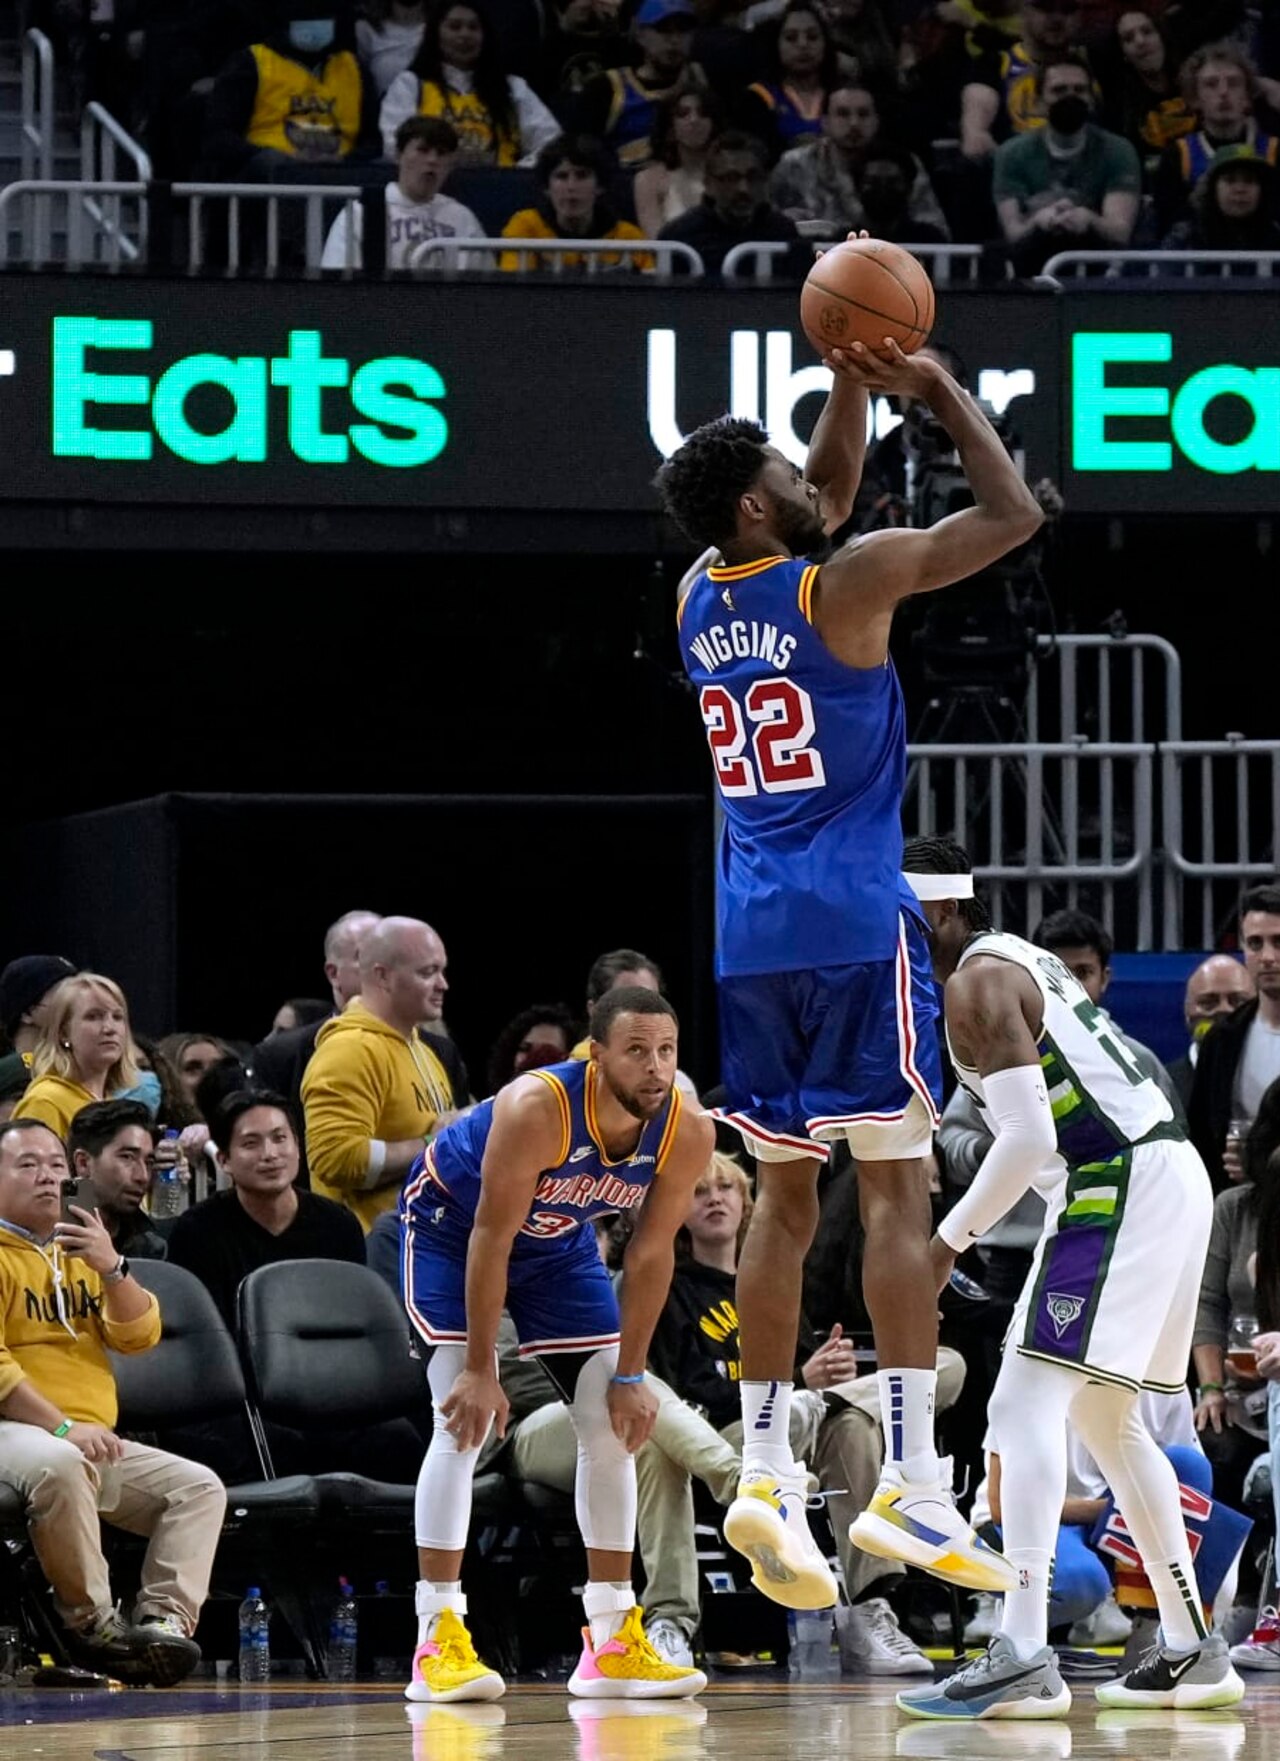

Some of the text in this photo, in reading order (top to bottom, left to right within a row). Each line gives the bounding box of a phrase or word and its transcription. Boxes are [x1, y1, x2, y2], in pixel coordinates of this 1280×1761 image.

[53, 316, 447, 466] Eats
[647, 329, 1035, 468] Ubr
[689, 620, 797, 674] WIGGINS
[701, 677, 827, 797] 22
